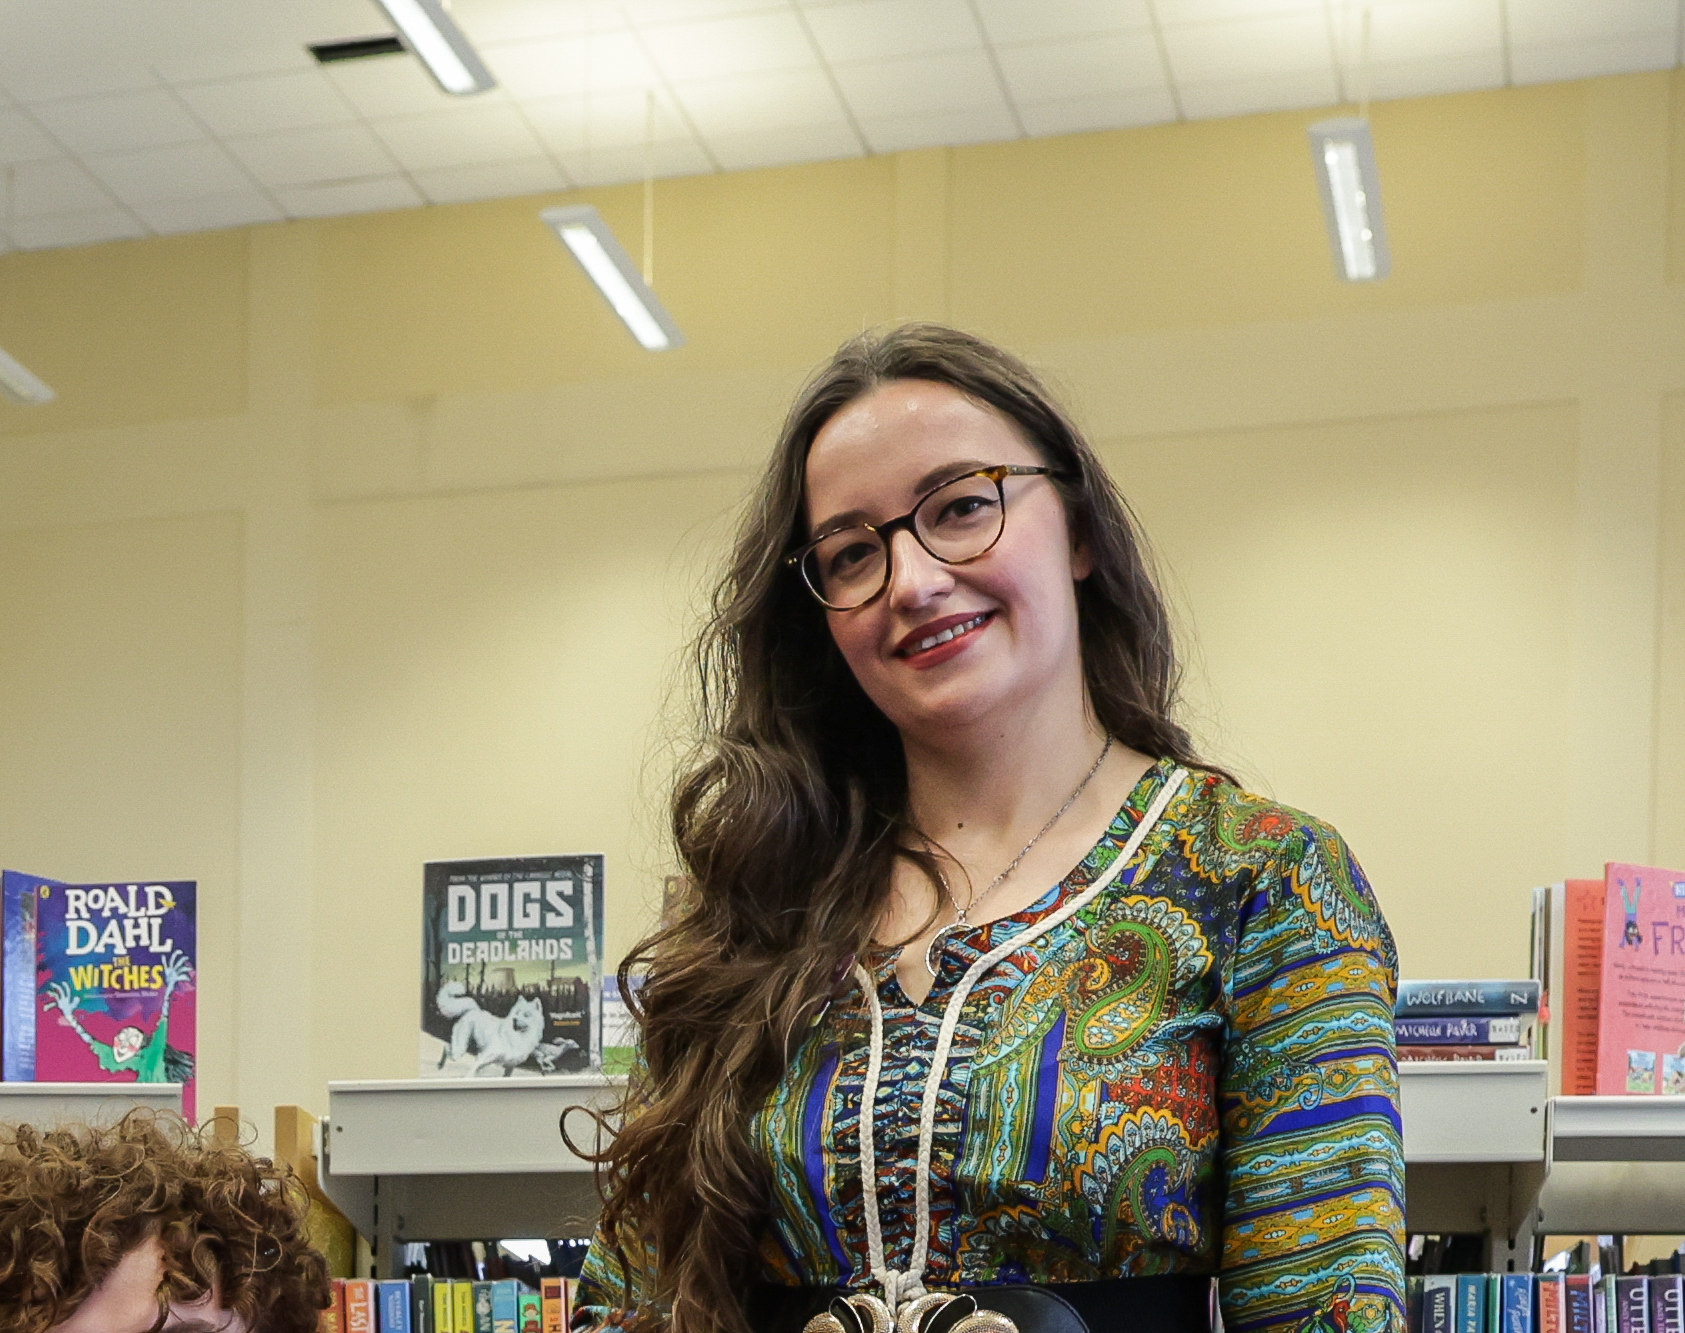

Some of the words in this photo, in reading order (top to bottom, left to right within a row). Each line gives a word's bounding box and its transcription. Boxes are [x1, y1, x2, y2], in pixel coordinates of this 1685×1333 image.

[65, 885, 174, 919] ROALD
[447, 880, 574, 932] DOGS
[65, 917, 173, 955] DAHL
[447, 937, 573, 965] DEADLANDS
[68, 964, 164, 991] WITCHES
[1406, 988, 1486, 1006] WOLFBANE
[349, 1301, 369, 1332] LAST
[1434, 1292, 1445, 1329] WHEN
[1466, 1284, 1476, 1317] MARIA
